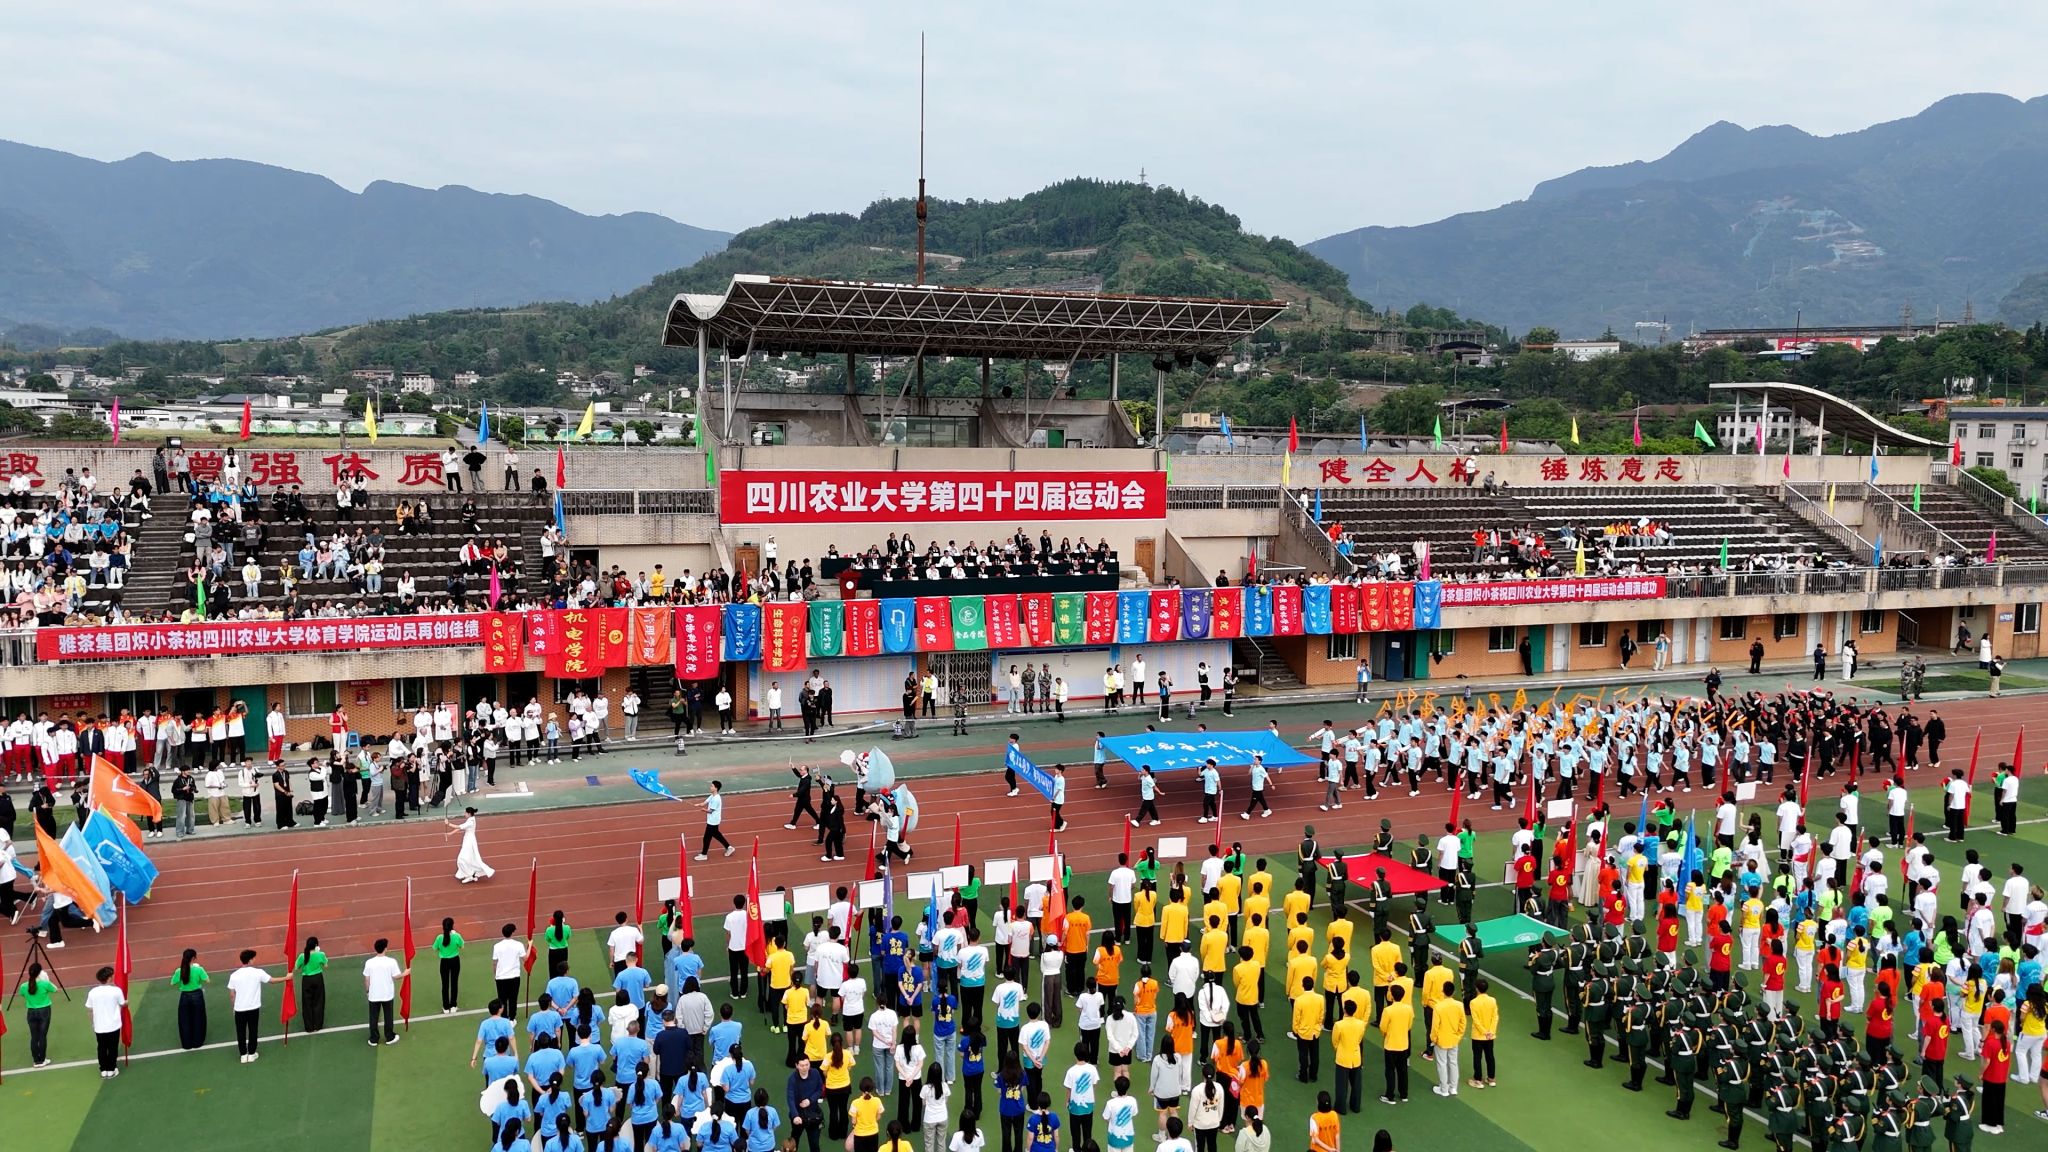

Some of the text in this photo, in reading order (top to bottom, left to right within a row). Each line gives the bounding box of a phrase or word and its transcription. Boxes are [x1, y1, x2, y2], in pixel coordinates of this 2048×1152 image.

[1540, 457, 1683, 482] 锤炼意志
[746, 480, 1146, 515] 四川农业大学第四十四届运动会
[59, 619, 479, 654] 雅茶集团炽小茶祝四川农业大学体育学院运动员再创佳绩
[563, 611, 588, 673] 机电学院
[772, 608, 784, 667] 生命科学学院
[955, 629, 986, 640] 食品学院
